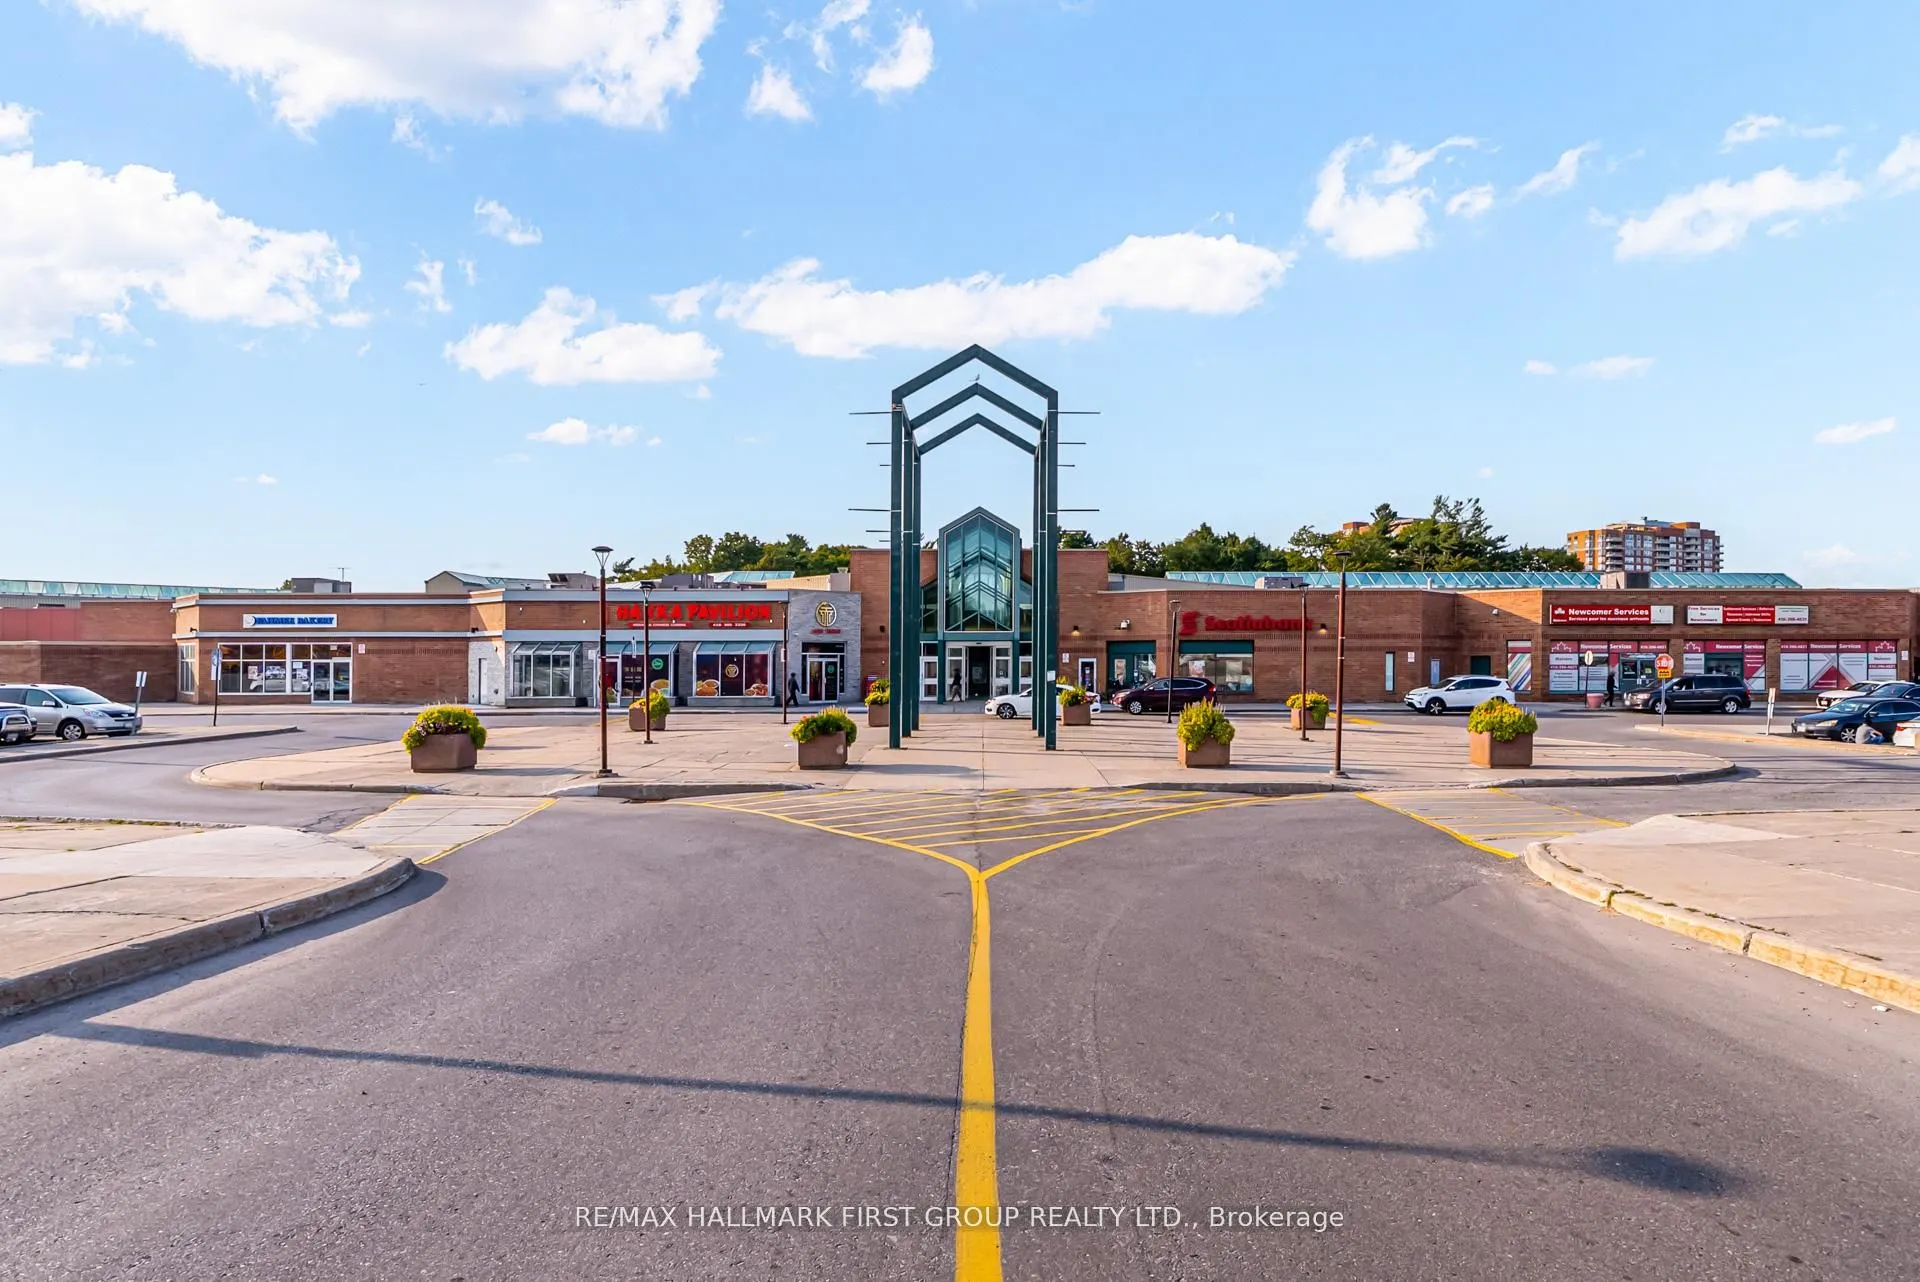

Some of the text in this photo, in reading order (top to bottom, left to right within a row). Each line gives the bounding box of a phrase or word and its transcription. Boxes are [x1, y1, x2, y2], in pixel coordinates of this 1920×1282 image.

[687, 603, 771, 620] PAVILION
[1568, 608, 1649, 616] Newcomer Services
